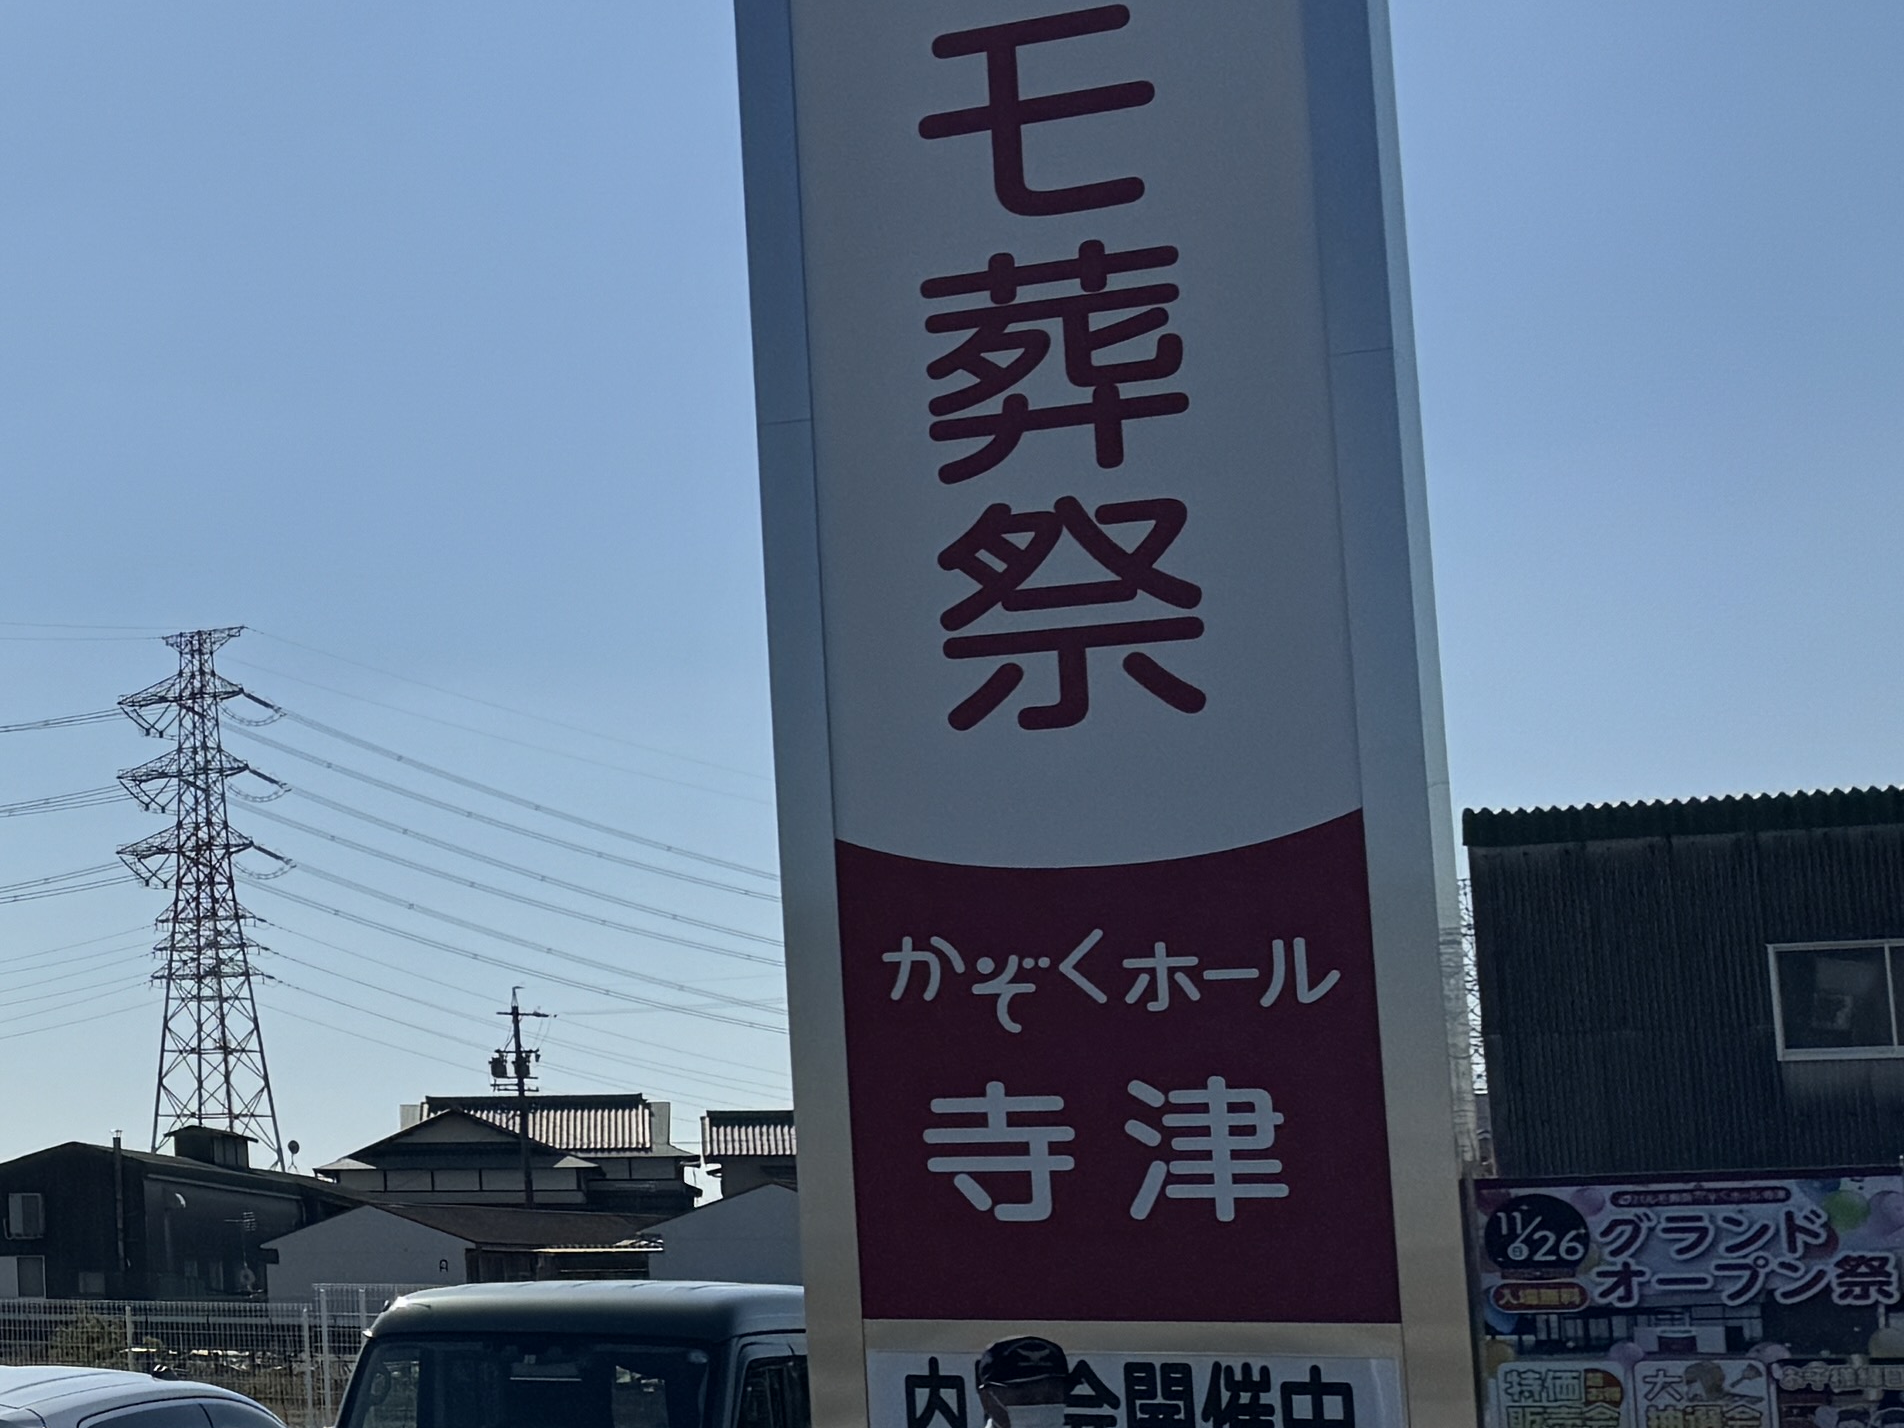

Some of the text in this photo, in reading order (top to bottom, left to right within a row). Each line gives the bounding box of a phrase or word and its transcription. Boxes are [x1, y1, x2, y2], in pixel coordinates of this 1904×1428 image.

[882, 928, 1341, 1034] かぞくホール
[922, 1075, 1290, 1223] 寺津
[1599, 1209, 1822, 1259] グランド
[1595, 1254, 1894, 1304] オープン祭
